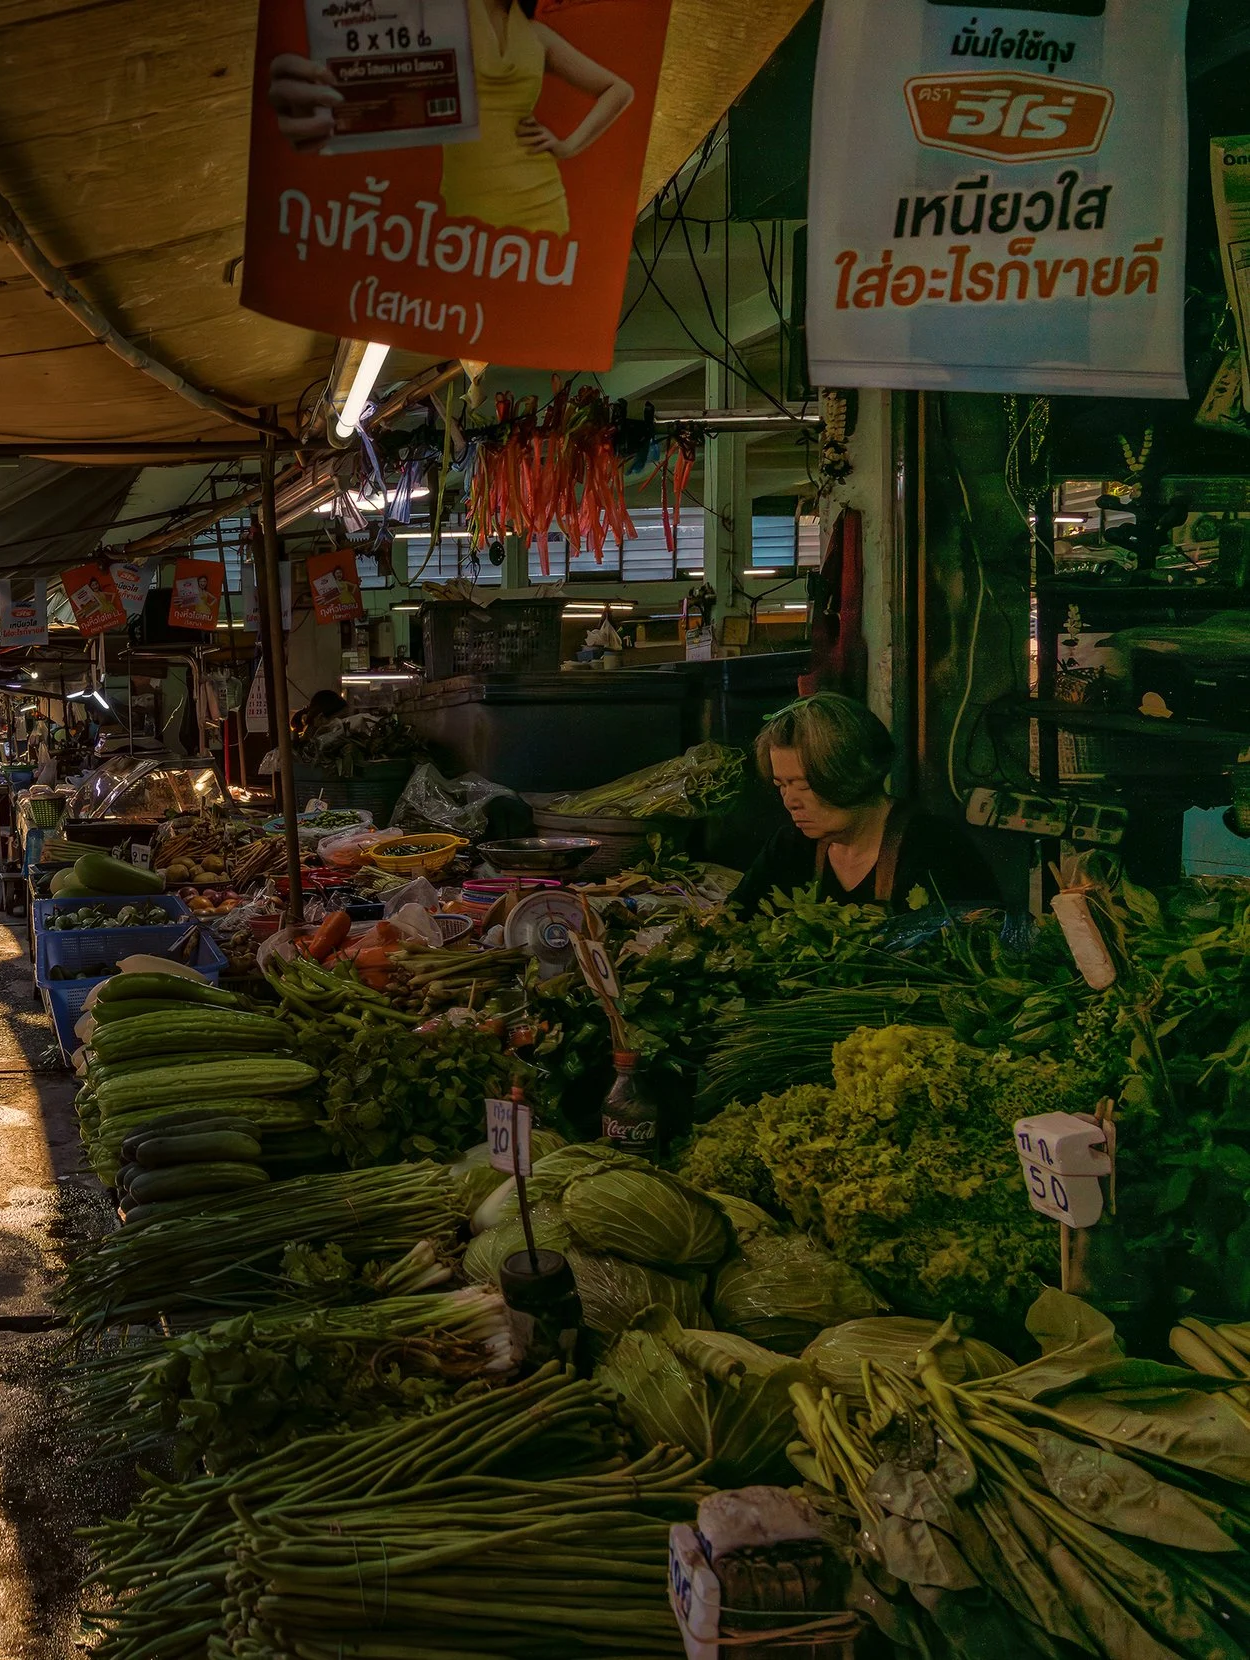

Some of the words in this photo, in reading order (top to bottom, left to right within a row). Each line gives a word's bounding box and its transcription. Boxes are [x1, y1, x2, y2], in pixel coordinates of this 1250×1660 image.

[346, 29, 359, 51] 8
[385, 26, 411, 48] 16
[918, 86, 952, 102] ตรา
[278, 176, 579, 285] ถุงหิ้วไฮเดน
[894, 169, 1112, 238] เหนียวใส
[835, 237, 1164, 310] ใส่อะไรก็ขายดี
[349, 276, 485, 345] (ใสหนา)
[491, 1126, 509, 1154] 10
[1029, 1165, 1069, 1212] 50
